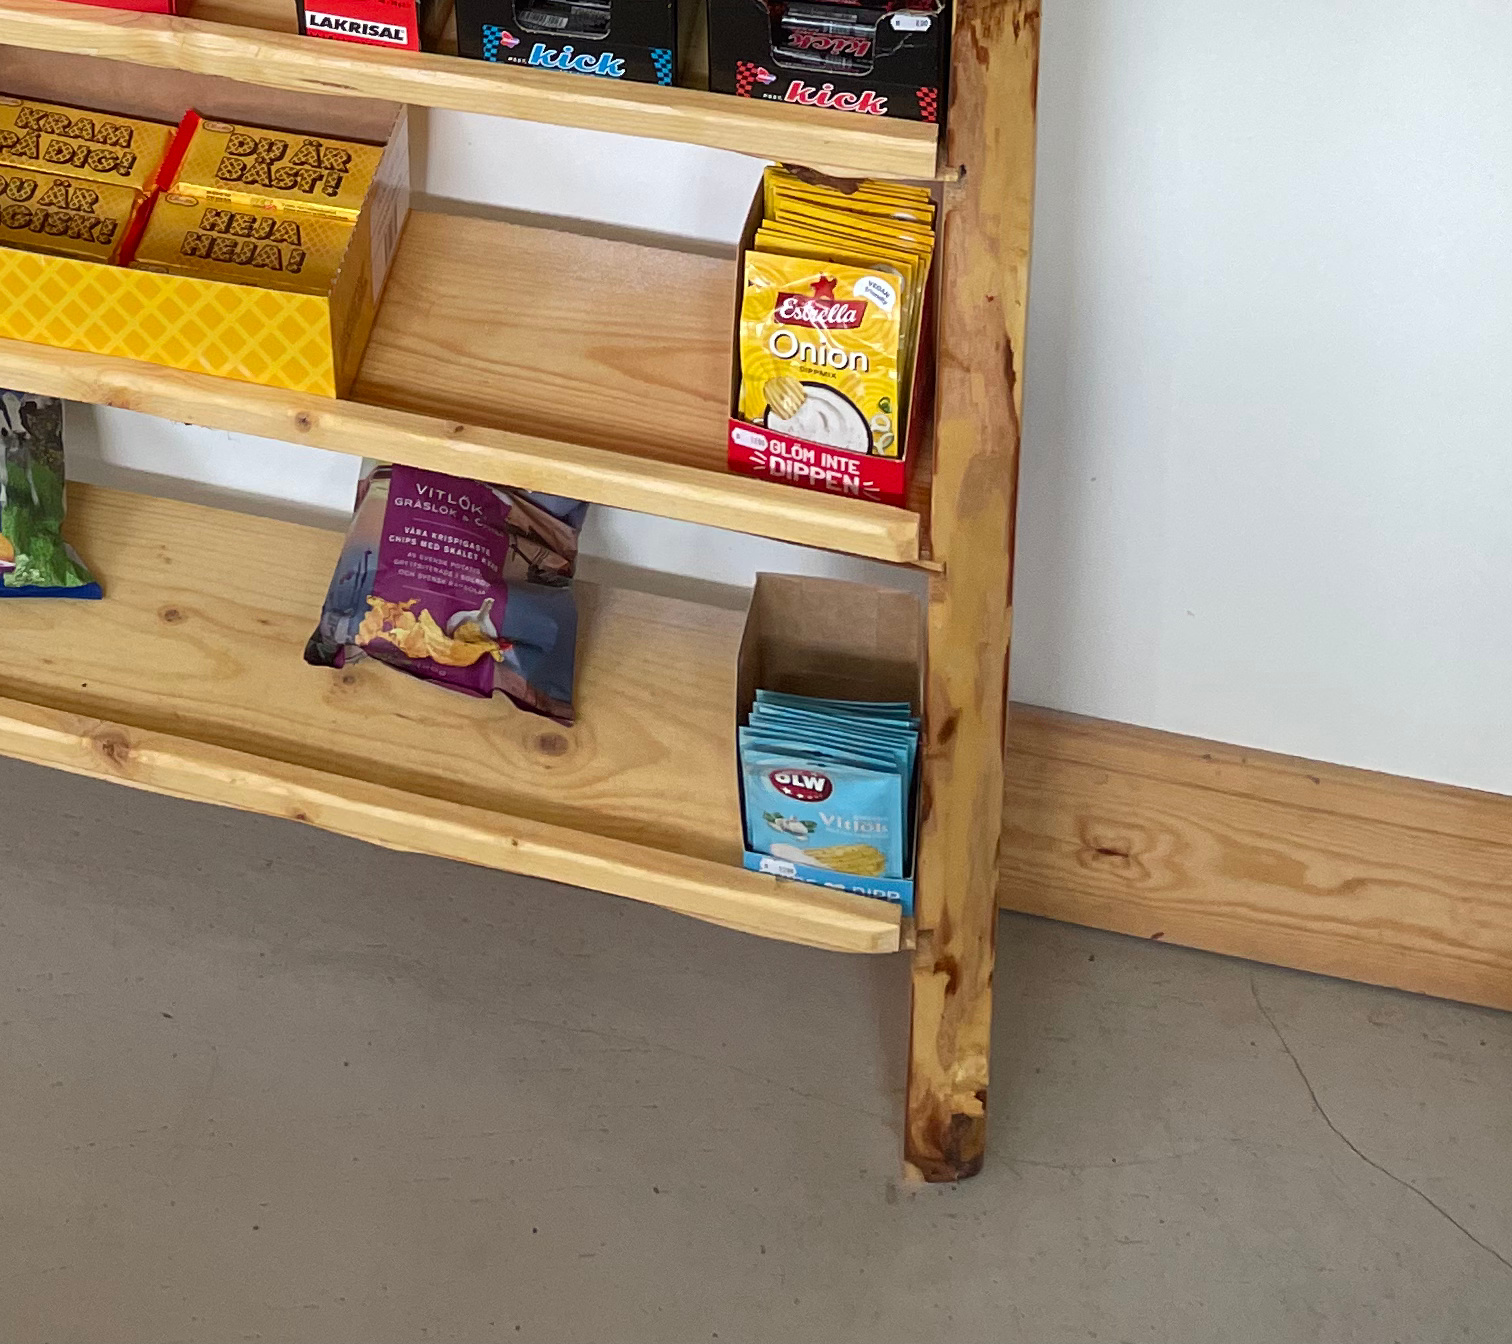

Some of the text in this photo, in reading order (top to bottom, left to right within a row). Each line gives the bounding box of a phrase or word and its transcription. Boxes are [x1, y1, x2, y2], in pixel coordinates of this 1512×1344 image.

[309, 14, 405, 43] LAKRISAL
[528, 42, 626, 79] kick
[784, 80, 889, 116] kick
[14, 105, 134, 149] KRAM
[42, 138, 137, 177] DIG!
[224, 131, 354, 174] DU ÄR
[215, 154, 345, 198] BÄST!
[37, 177, 100, 215] ÄR
[198, 207, 303, 247] HEJA
[180, 230, 307, 275] HEJA!
[864, 286, 888, 308] friendly
[867, 278, 892, 299] VEGAN
[778, 296, 858, 325] Estrella
[768, 328, 870, 374] Onion
[798, 365, 838, 380] DIPPMIX
[768, 440, 861, 476] GLÖM INTE
[768, 455, 861, 496] DIPPEN
[389, 534, 480, 561] CHIPS MED SKALET
[404, 525, 429, 538] VÅRA
[775, 771, 827, 793] OLW
